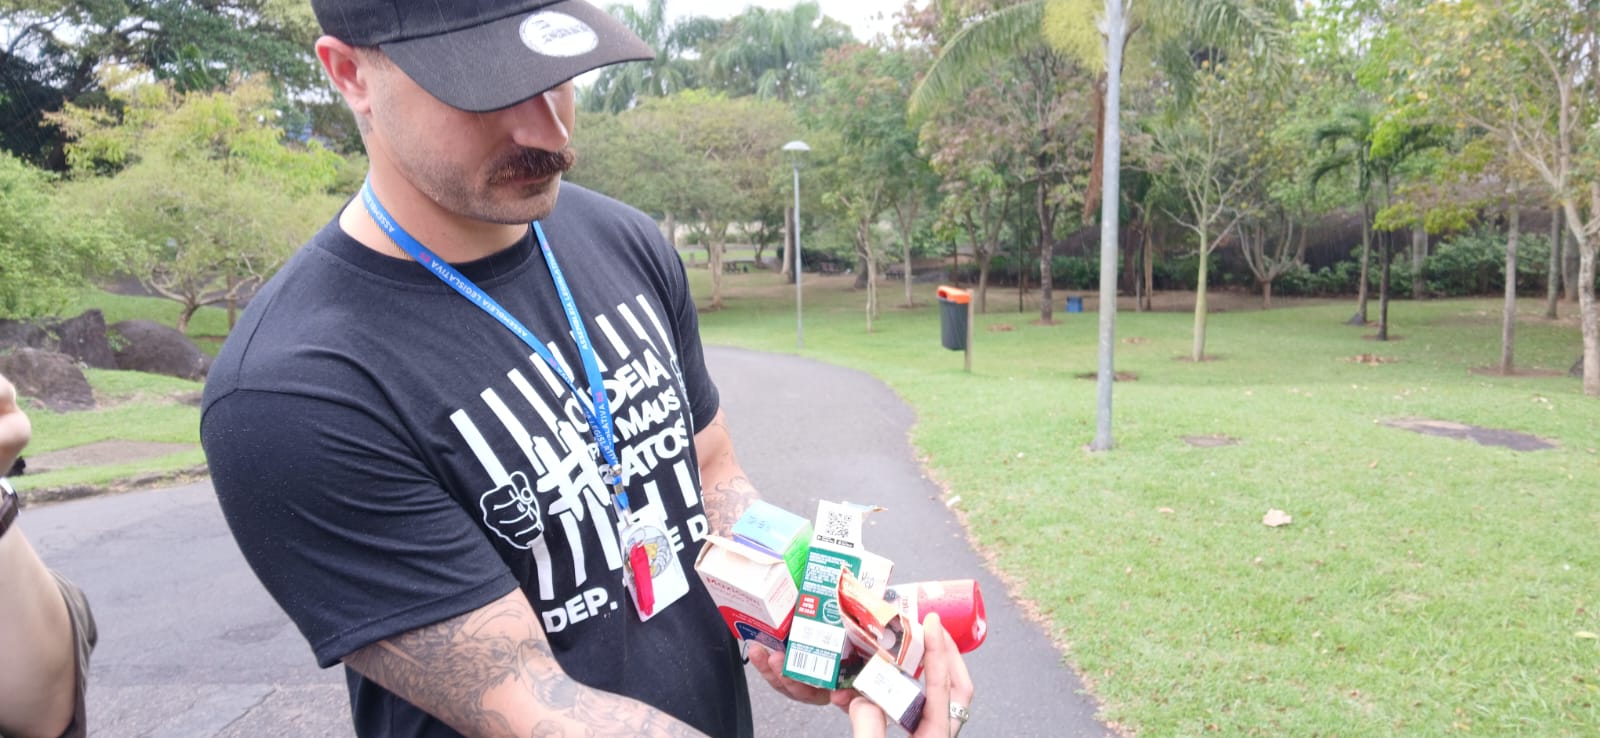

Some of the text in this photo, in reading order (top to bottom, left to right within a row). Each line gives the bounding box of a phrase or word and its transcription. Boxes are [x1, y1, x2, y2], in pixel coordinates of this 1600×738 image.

[431, 260, 483, 301] LEGISLATIVA
[482, 299, 528, 337] ASSEMBLEIA
[614, 385, 681, 441] MAUS
[542, 587, 618, 633] DEP.
